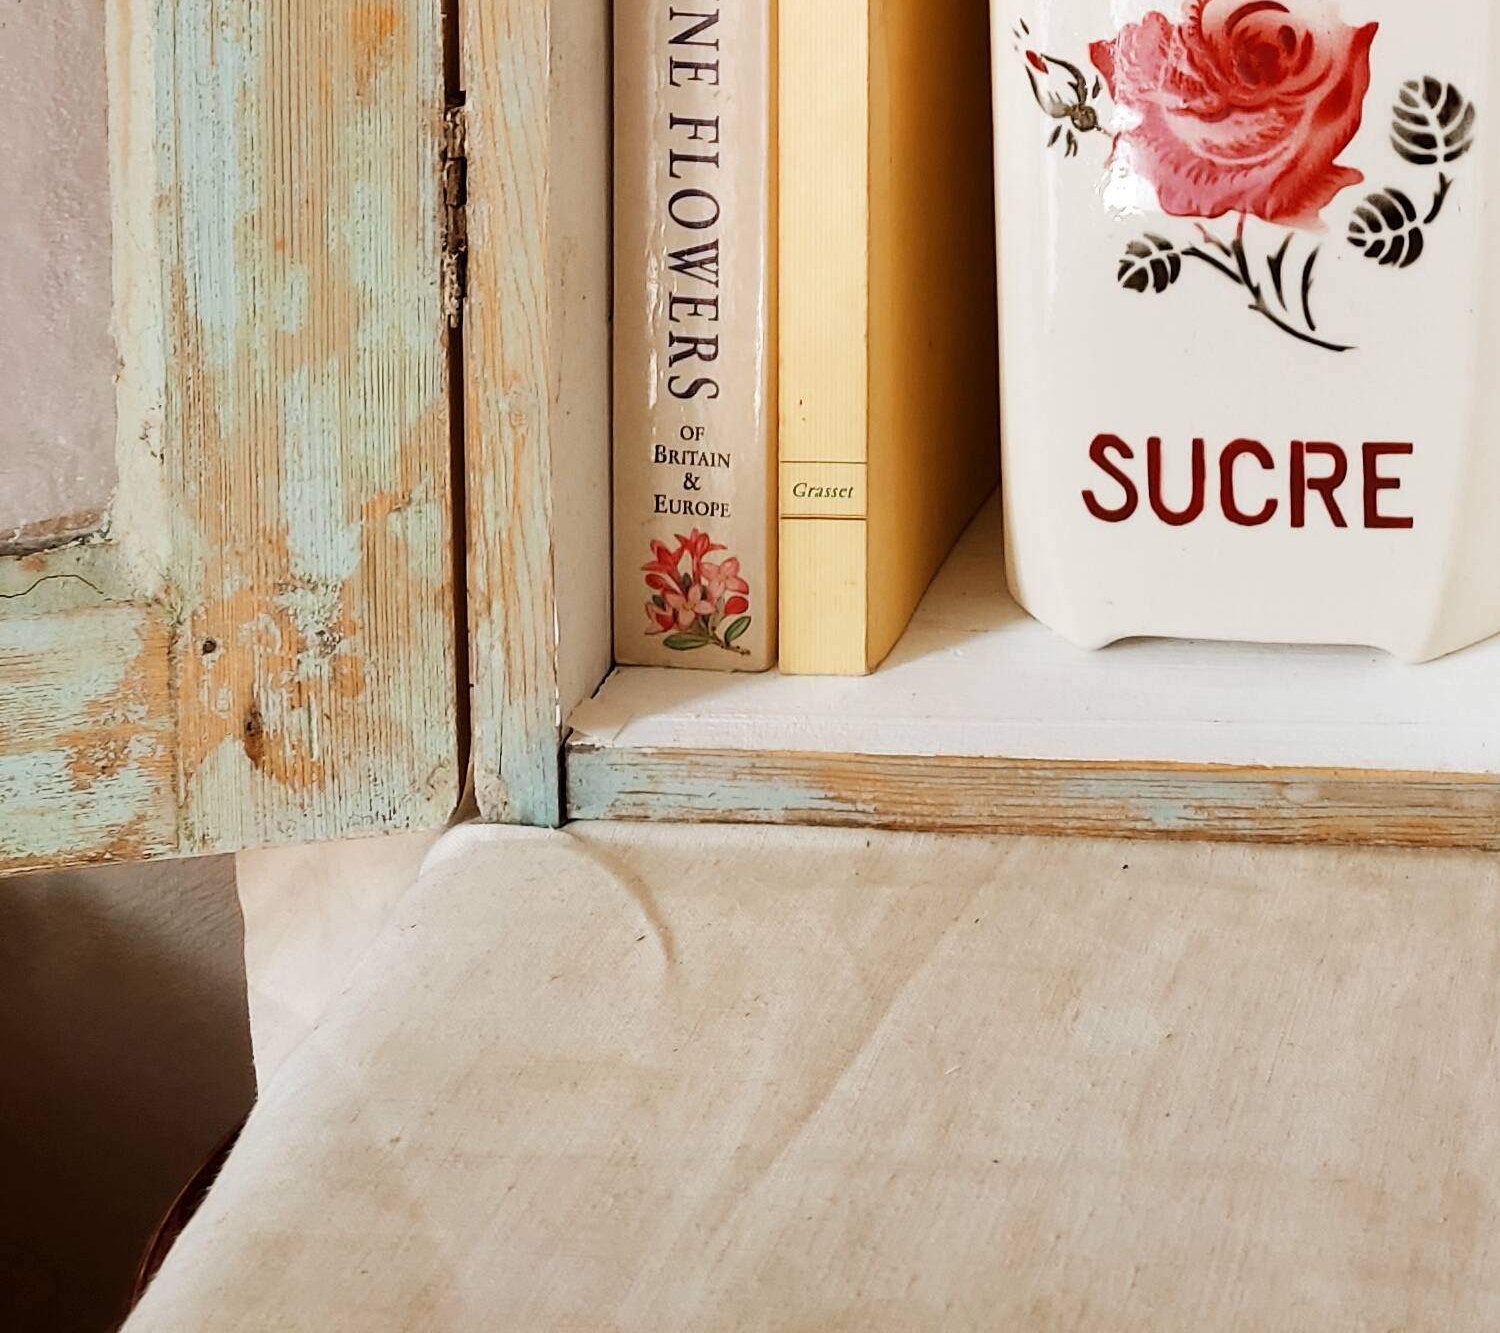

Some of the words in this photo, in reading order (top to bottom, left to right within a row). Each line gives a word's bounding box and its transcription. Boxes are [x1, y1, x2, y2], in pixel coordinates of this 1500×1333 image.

[668, 113, 719, 399] FLOWERS
[680, 426, 704, 441] OF
[654, 445, 729, 467] BRITAIN
[684, 473, 700, 490] &
[792, 480, 855, 499] Grasset
[1082, 434, 1413, 528] SUCRE
[654, 494, 731, 518] EUROPE
